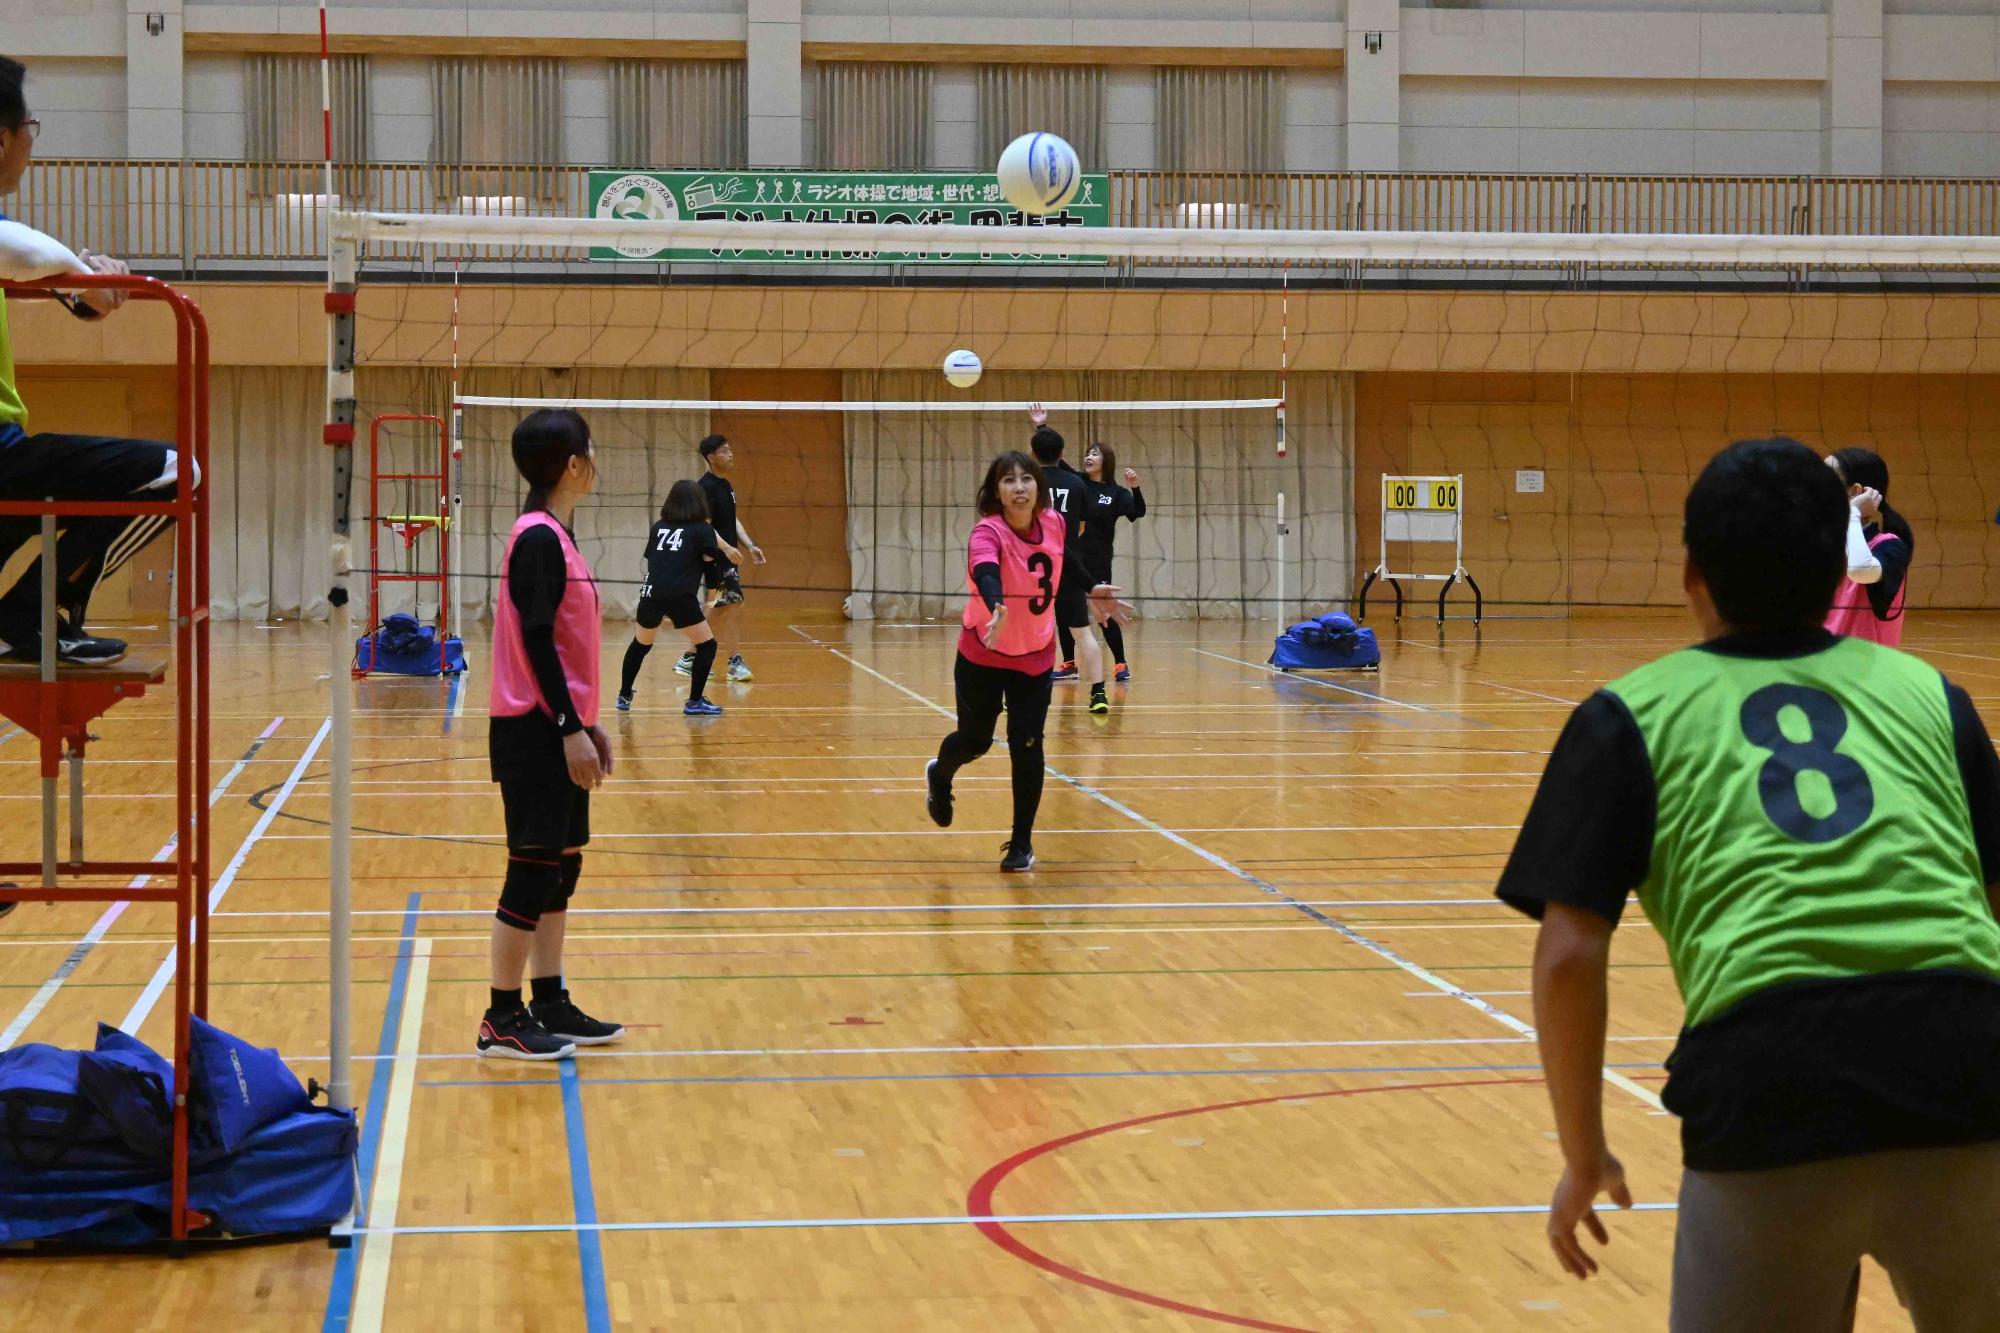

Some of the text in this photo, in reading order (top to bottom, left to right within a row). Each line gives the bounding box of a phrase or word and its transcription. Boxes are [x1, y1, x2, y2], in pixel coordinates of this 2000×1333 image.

[1098, 493, 1112, 505] 23
[1396, 485, 1457, 507] 00 00
[656, 528, 684, 552] 74
[1027, 551, 1054, 616] 3
[1740, 682, 1875, 844] 8
